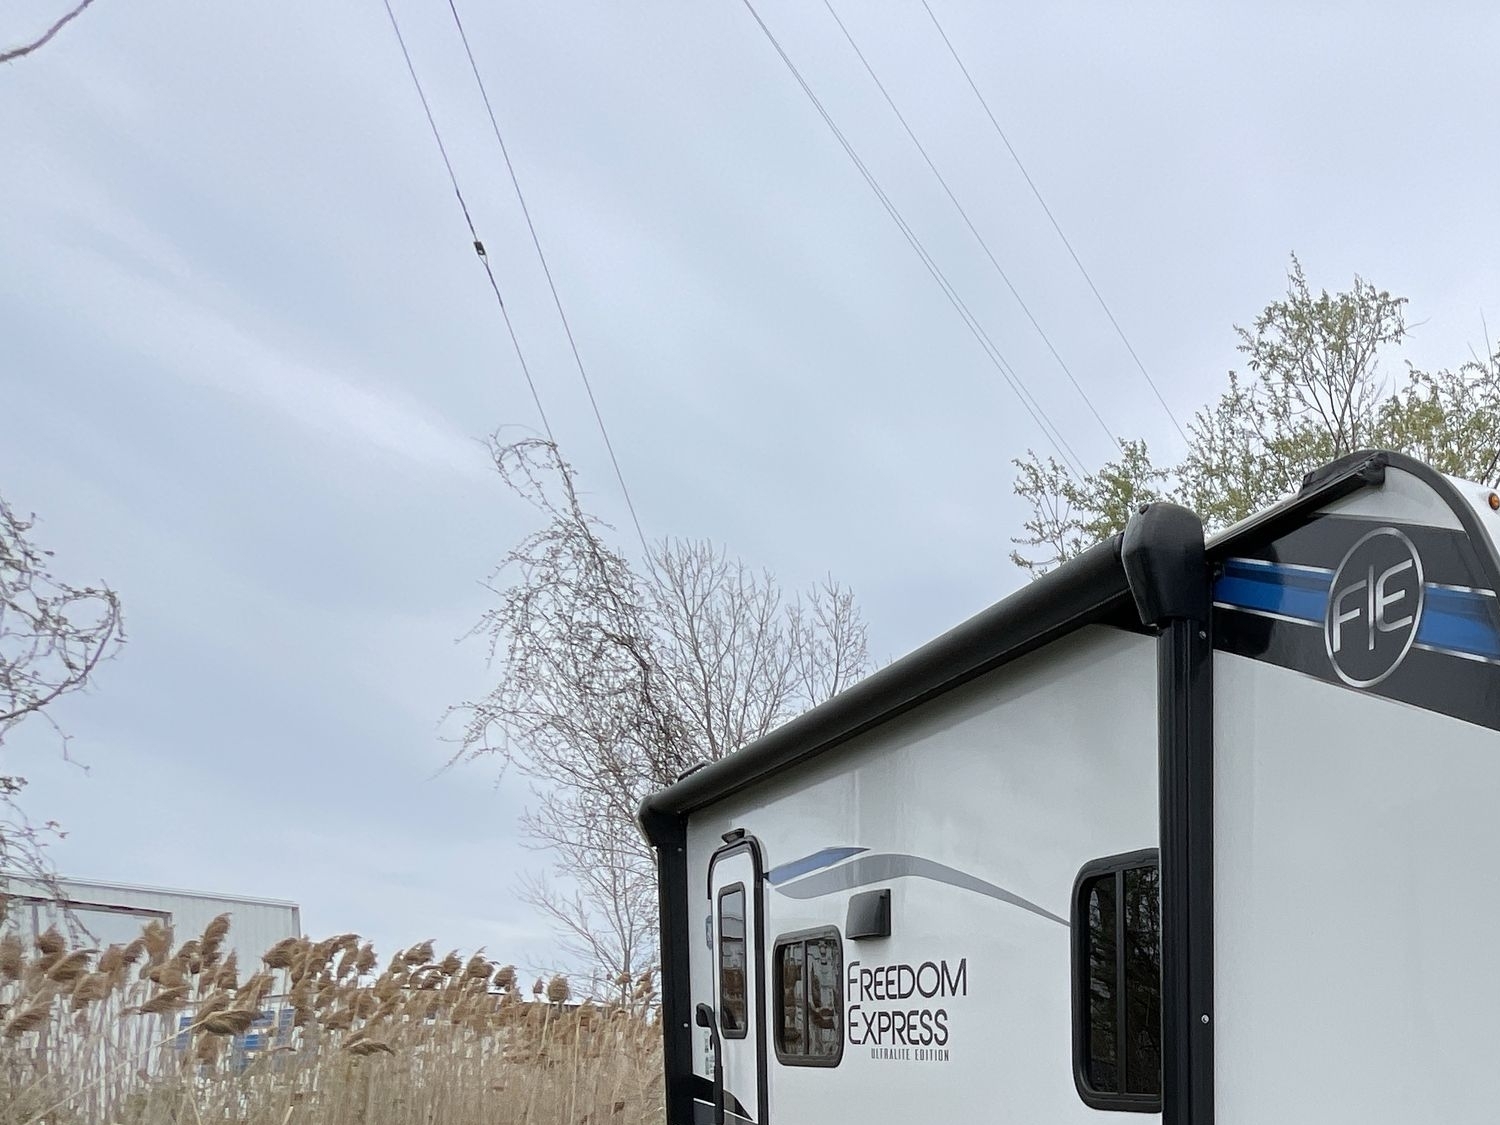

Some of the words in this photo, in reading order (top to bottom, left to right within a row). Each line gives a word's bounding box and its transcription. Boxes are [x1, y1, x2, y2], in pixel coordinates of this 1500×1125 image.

[847, 958, 967, 1002] FREEDOM
[848, 1004, 949, 1046] EXPRESS
[870, 1048, 910, 1061] ULTRALITE
[914, 1049, 949, 1062] EDITION
